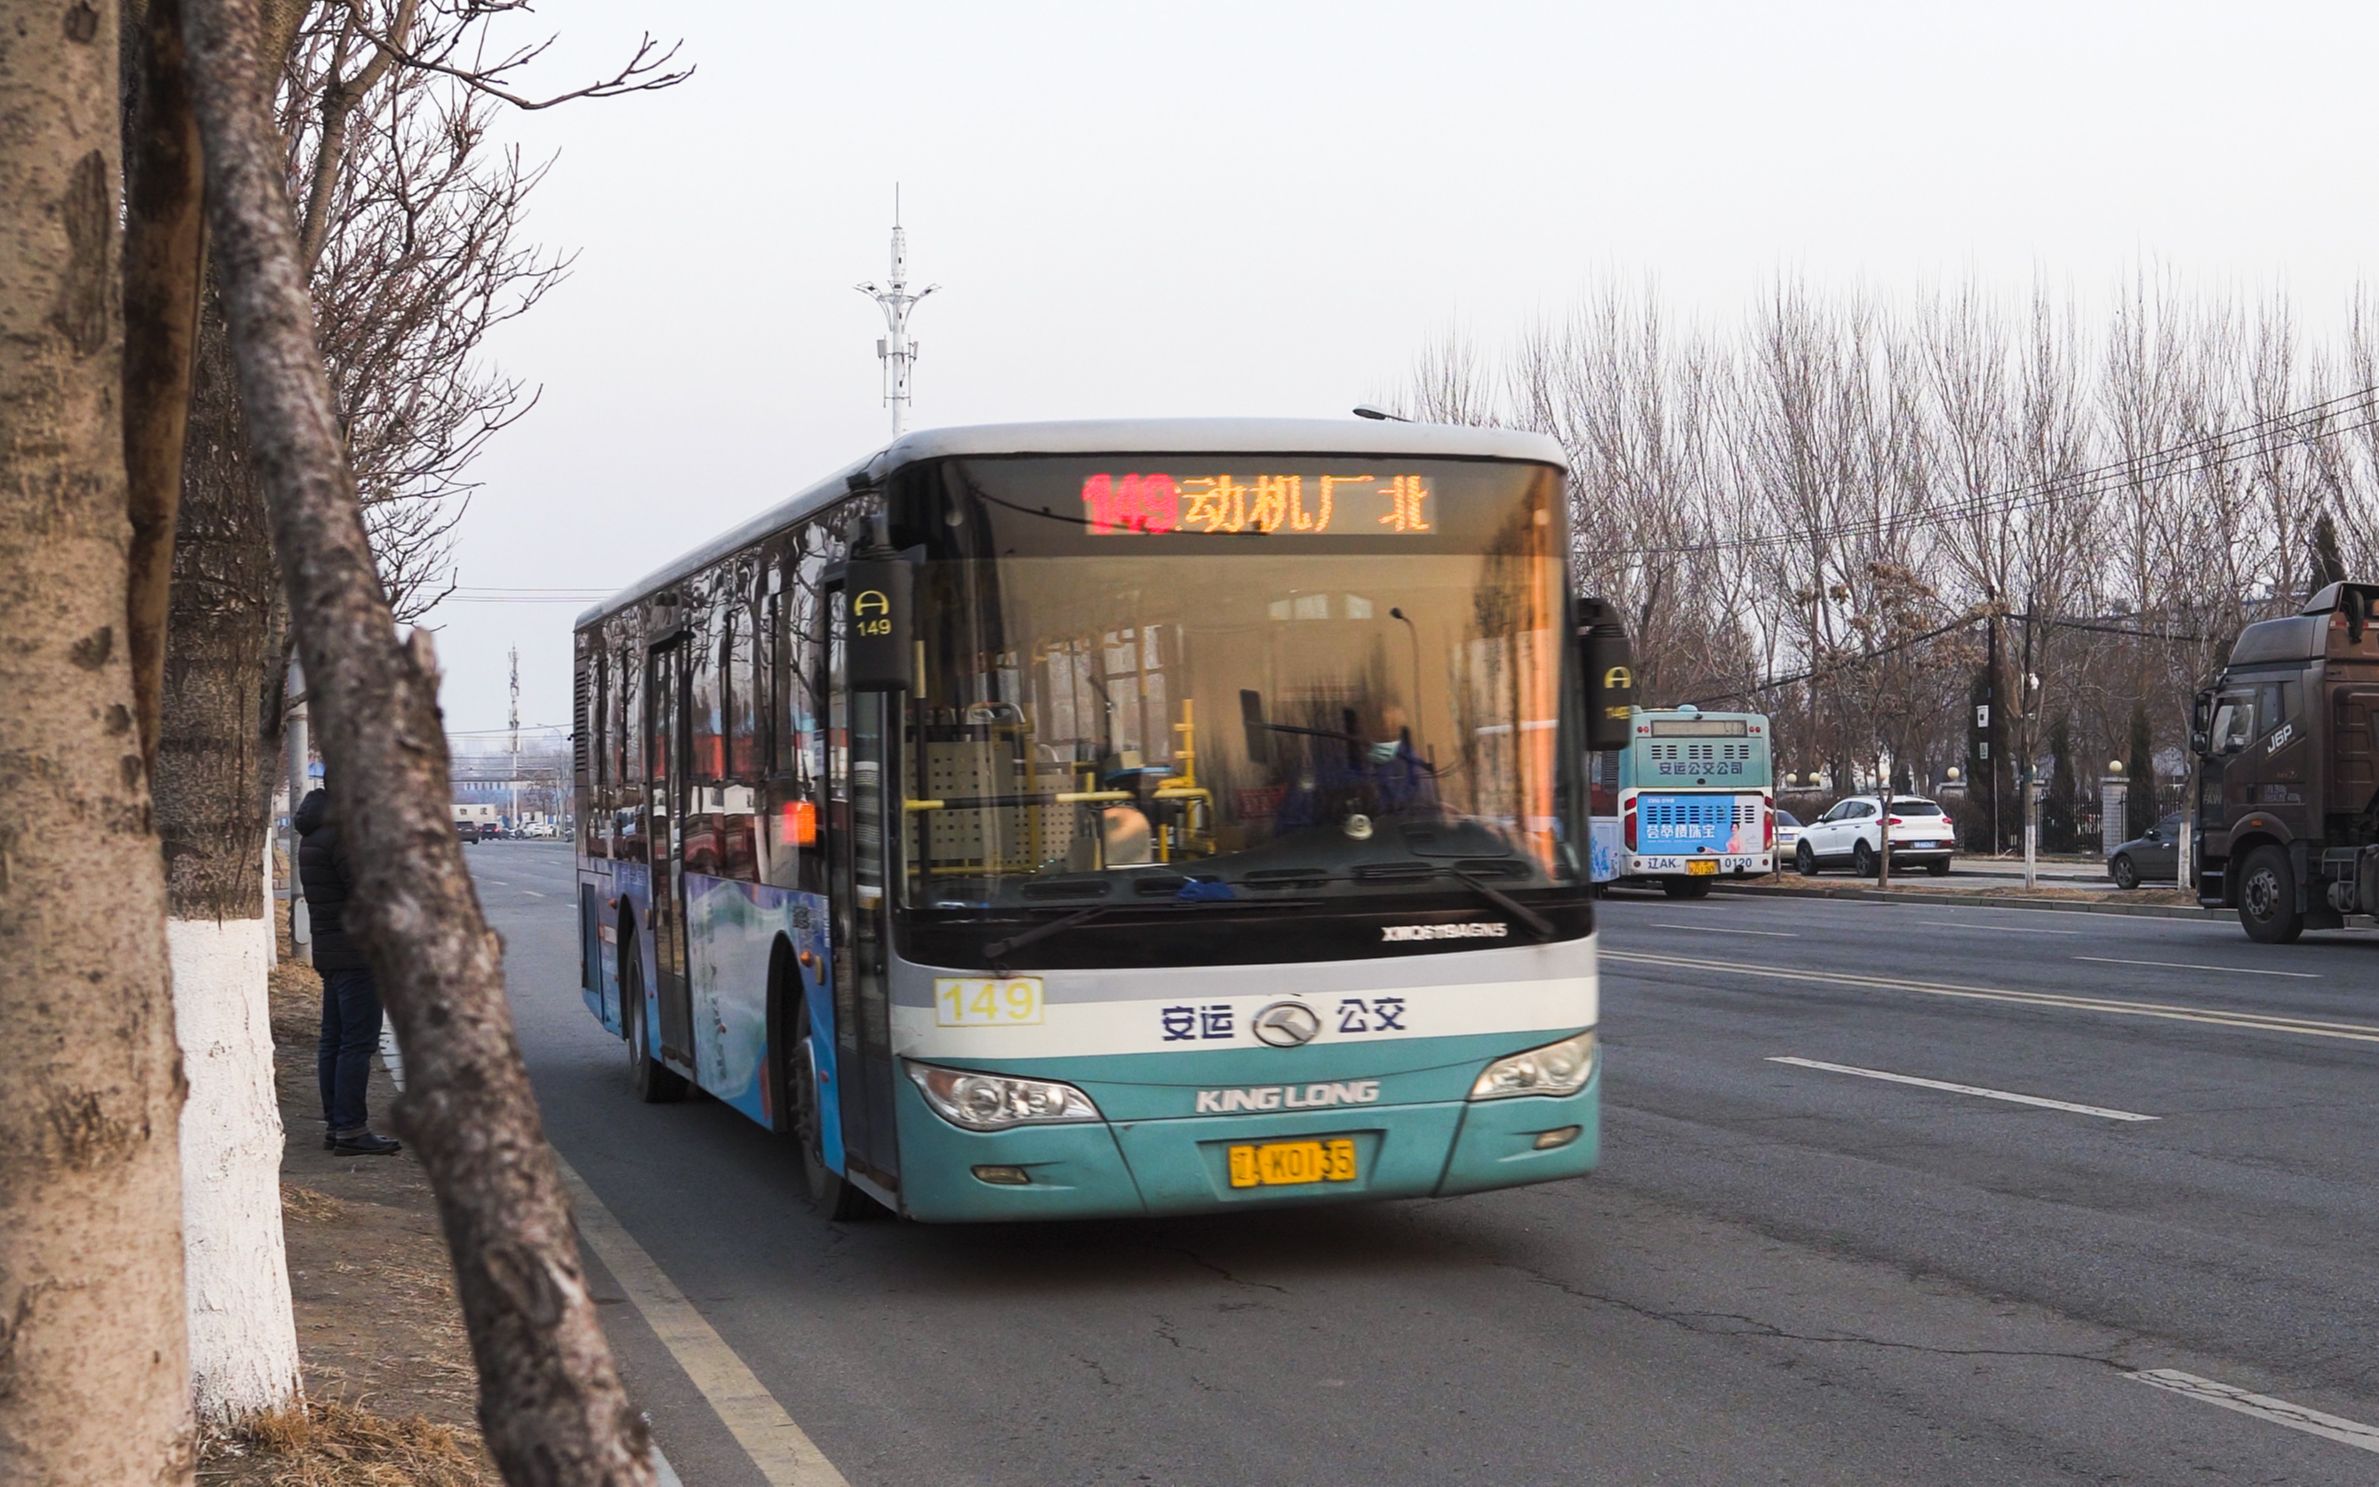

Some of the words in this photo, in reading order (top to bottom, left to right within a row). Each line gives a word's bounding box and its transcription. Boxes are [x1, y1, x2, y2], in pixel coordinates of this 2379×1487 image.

[856, 619, 891, 636] 149
[2267, 724, 2293, 753] J6P
[1659, 762, 1743, 775] 安运公交公司
[1724, 857, 1753, 869] 0120
[943, 982, 1034, 1021] 149
[1161, 1005, 1234, 1041] 安运
[1337, 997, 1406, 1034] 公交
[1195, 1086, 1283, 1114] KING
[1284, 1080, 1380, 1109] LONG
